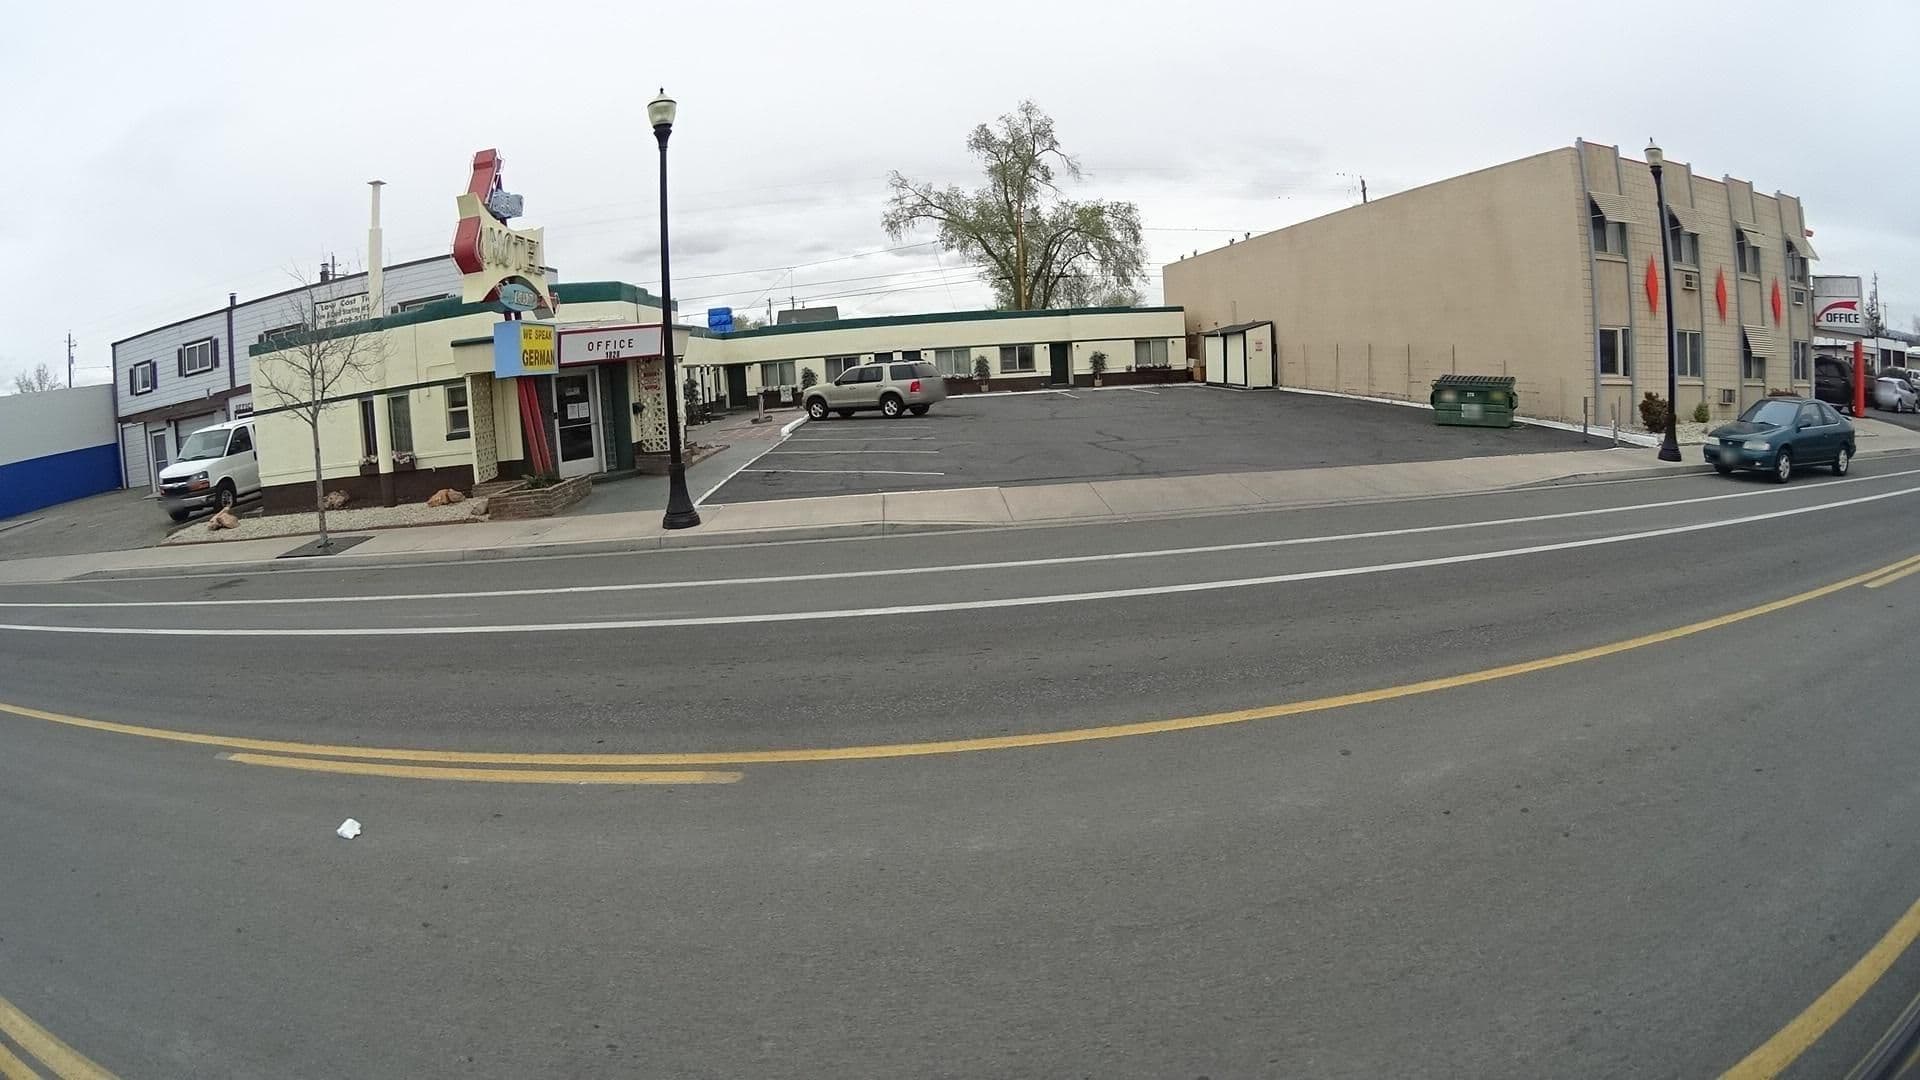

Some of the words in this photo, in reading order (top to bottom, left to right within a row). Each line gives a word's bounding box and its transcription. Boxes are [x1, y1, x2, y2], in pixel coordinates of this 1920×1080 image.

[486, 227, 545, 276] MOTEL
[340, 298, 356, 307] Cost
[1826, 312, 1860, 323] OFFICE
[523, 328, 533, 340] WE
[535, 328, 553, 341] SPEAK
[587, 338, 634, 352] OFFICE
[522, 348, 555, 366] GERMAN
